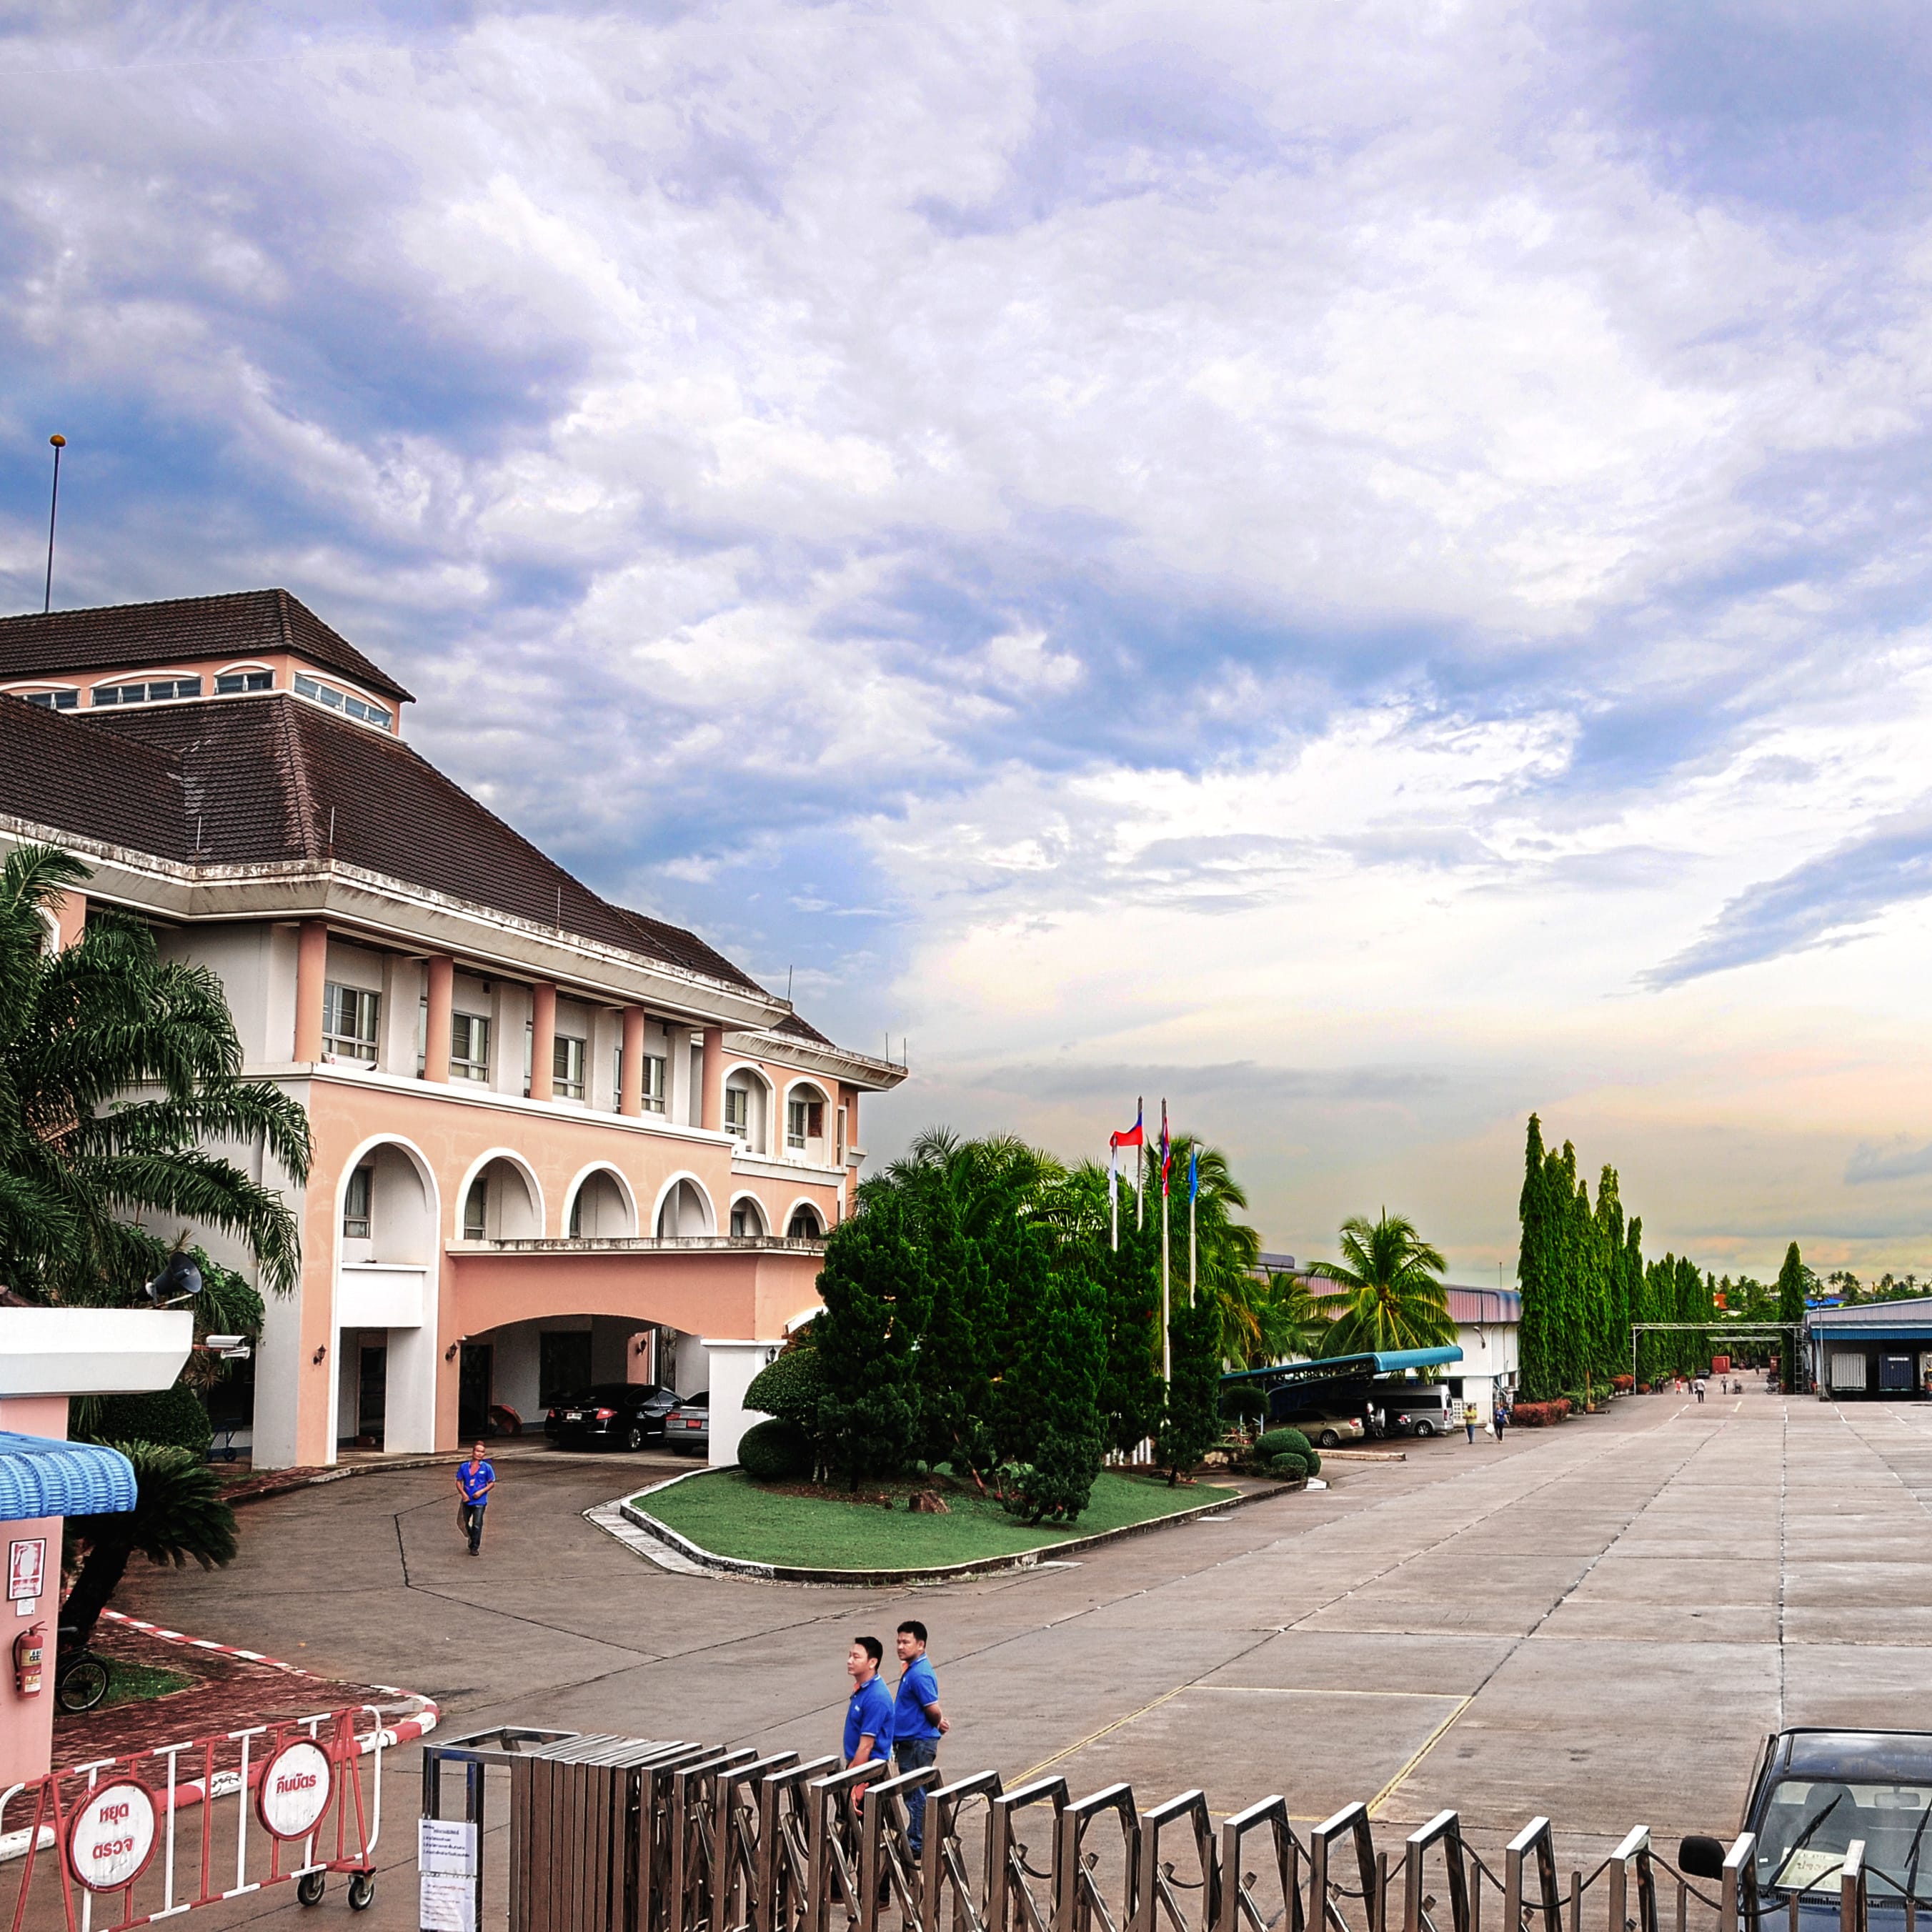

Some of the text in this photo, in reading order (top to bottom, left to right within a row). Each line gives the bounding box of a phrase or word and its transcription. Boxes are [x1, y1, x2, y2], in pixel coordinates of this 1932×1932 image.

[277, 1773, 316, 1794] คืนบัตร
[99, 1803, 129, 1825] หยุด
[93, 1838, 133, 1859] ตรวจ
